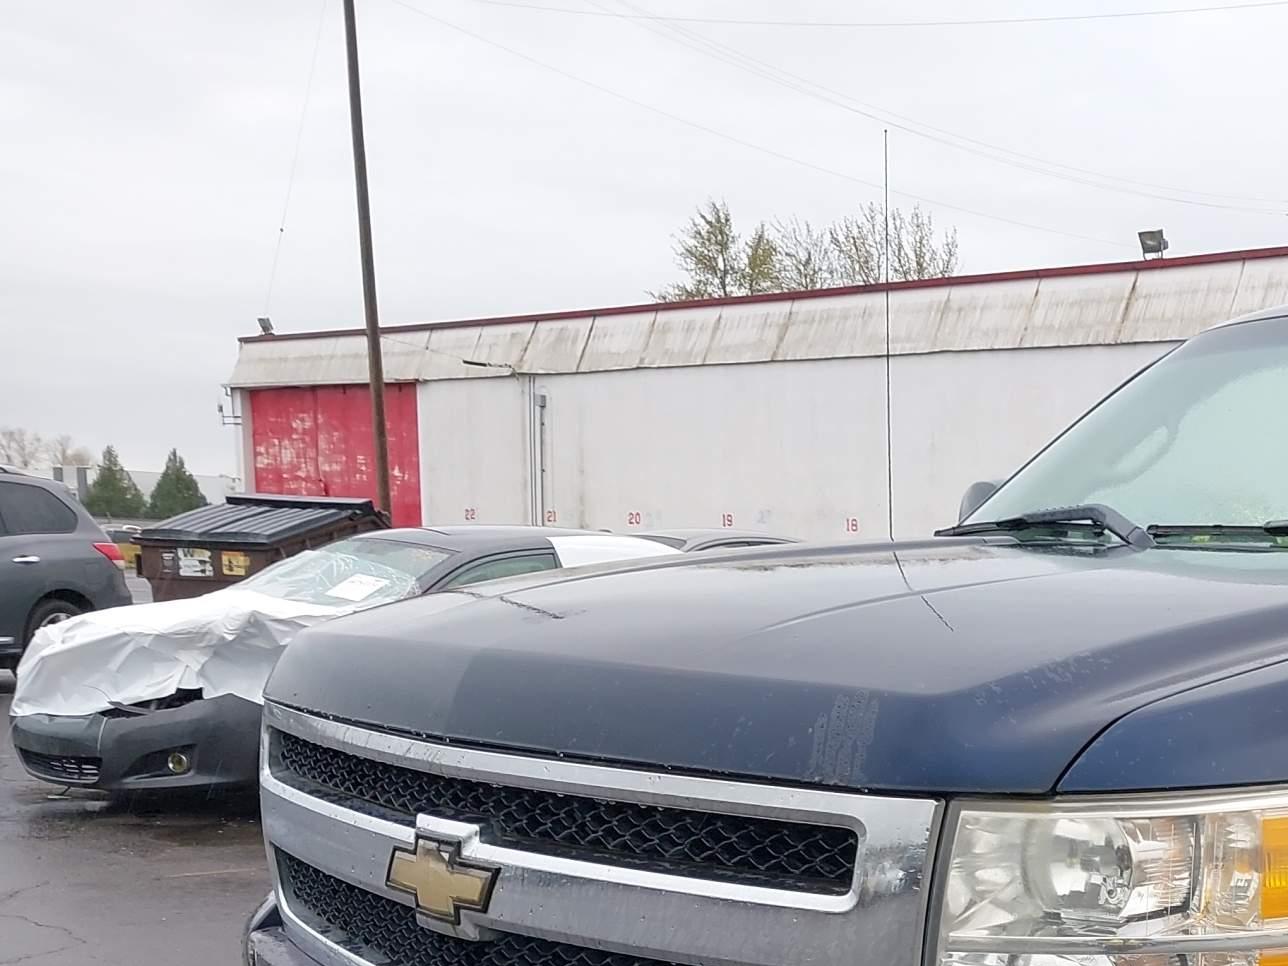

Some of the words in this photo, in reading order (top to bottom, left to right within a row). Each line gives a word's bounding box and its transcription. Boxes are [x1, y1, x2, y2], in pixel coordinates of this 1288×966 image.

[464, 508, 476, 521] 22
[546, 510, 557, 522] 21
[628, 512, 641, 526] 20
[722, 514, 733, 528] 19
[846, 518, 858, 532] 18
